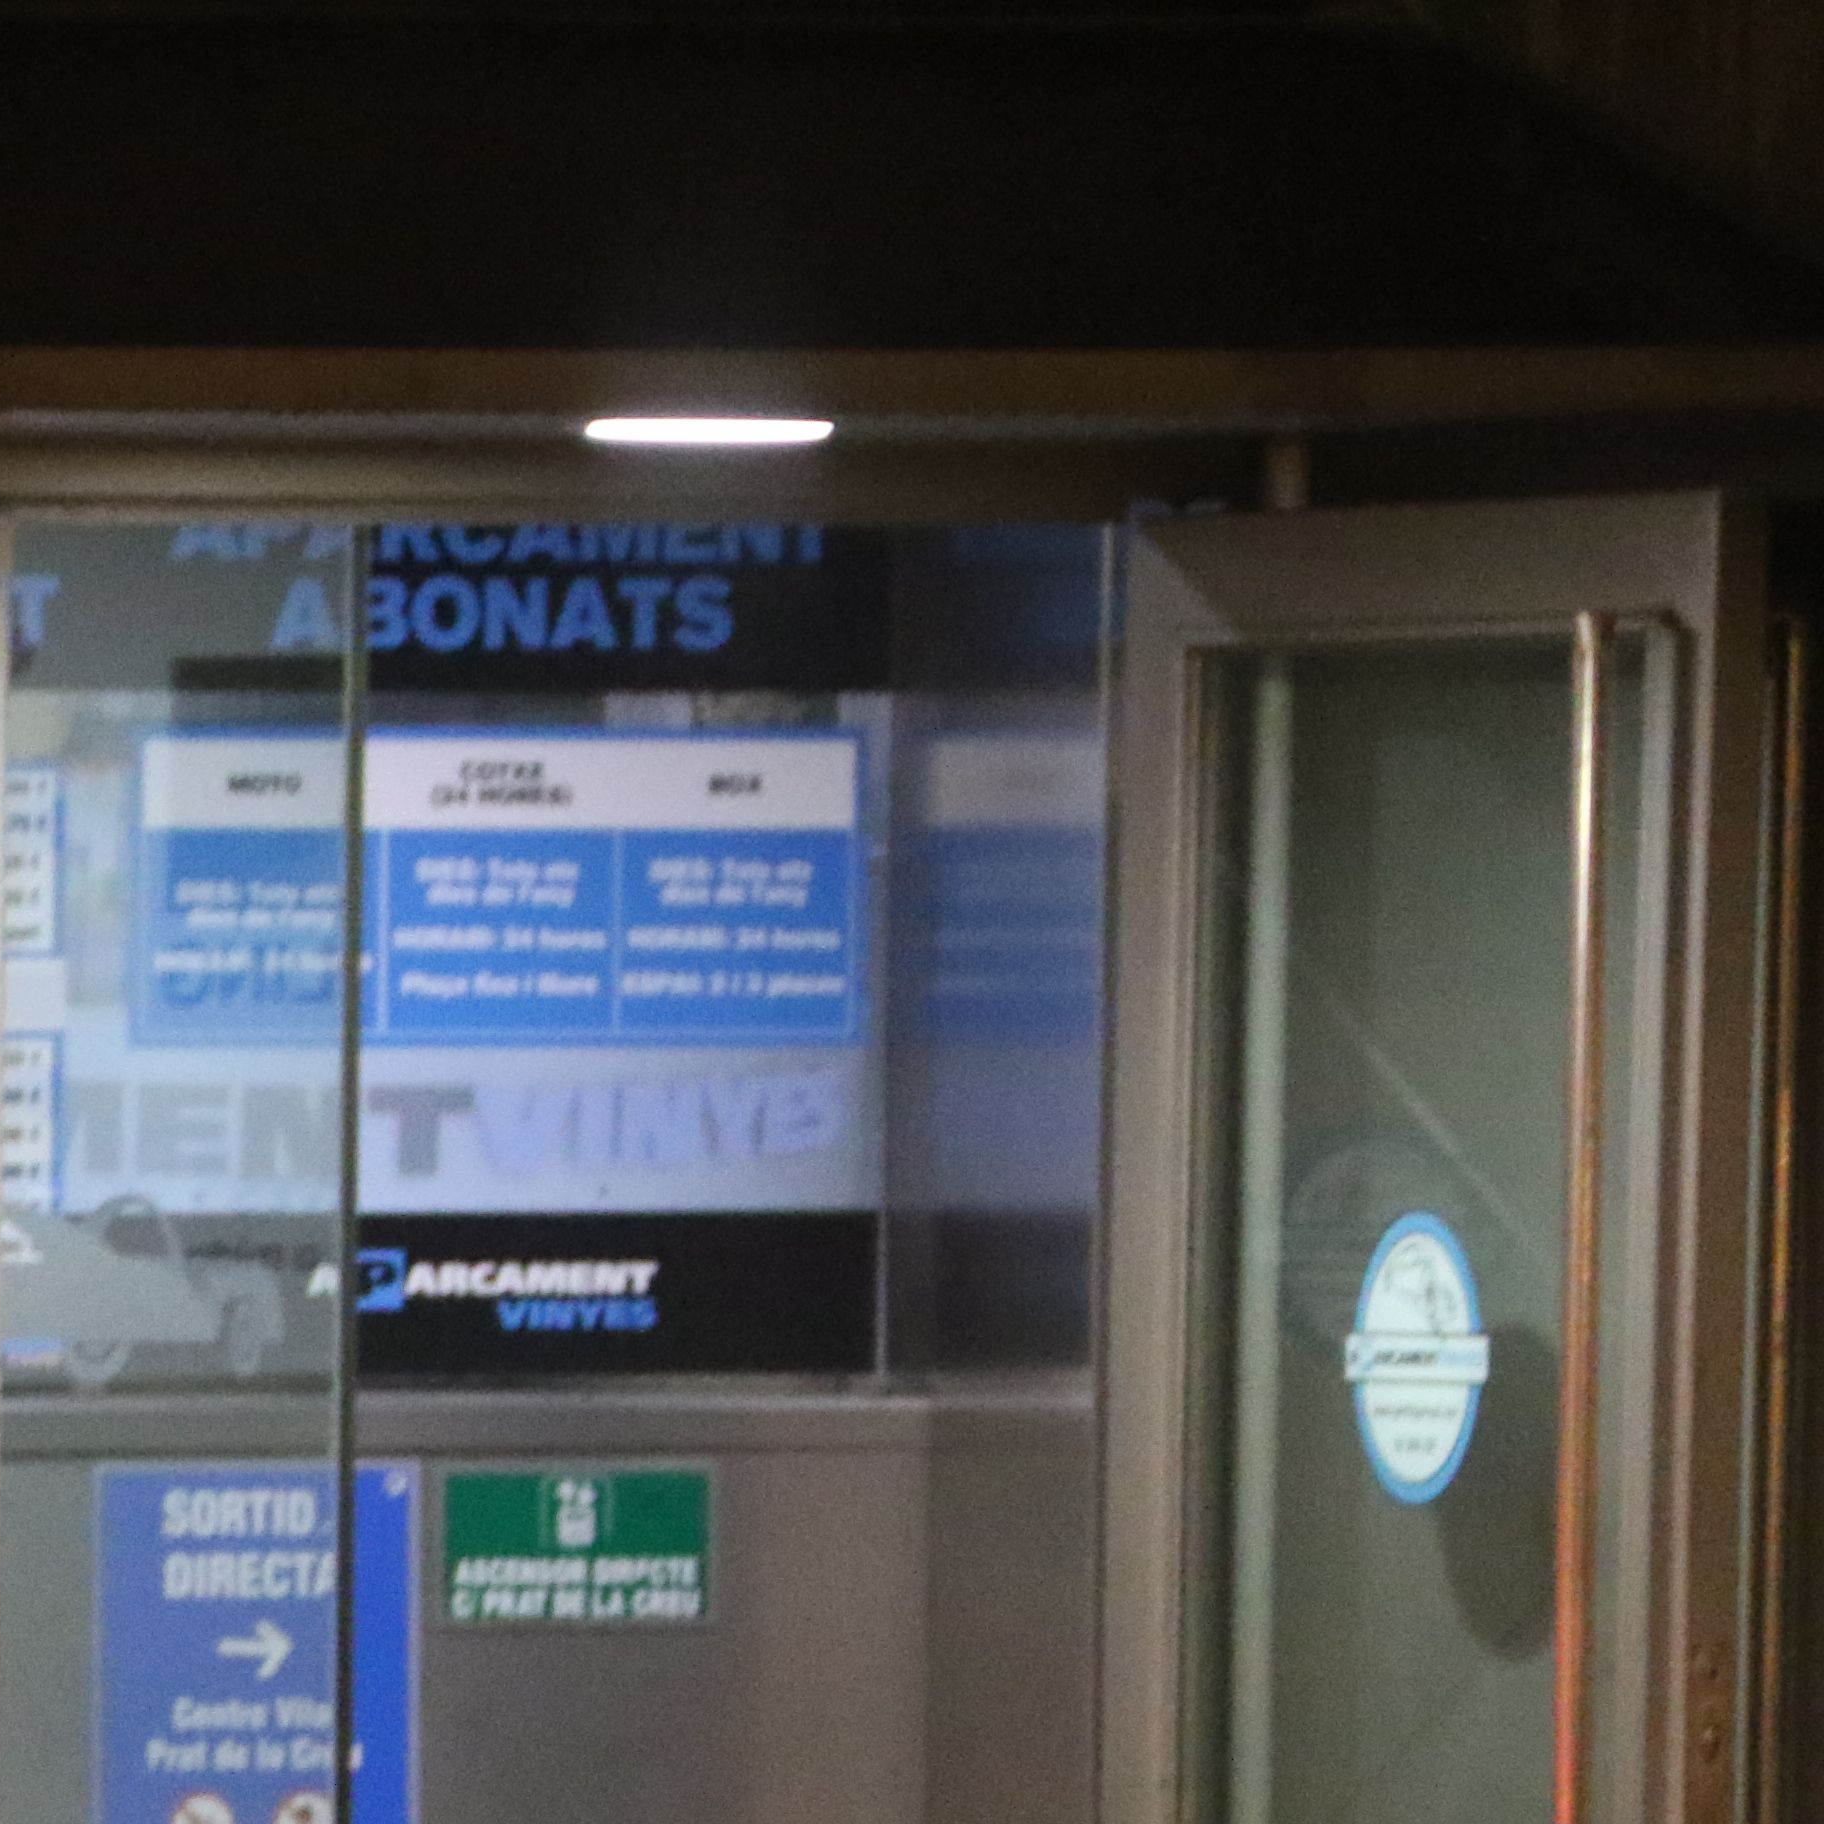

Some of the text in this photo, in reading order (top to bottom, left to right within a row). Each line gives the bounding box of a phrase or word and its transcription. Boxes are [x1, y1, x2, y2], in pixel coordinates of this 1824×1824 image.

[271, 574, 734, 652] ABONATS
[498, 1297, 655, 1331] VINYES
[162, 1488, 334, 1538] SORTID
[146, 1737, 206, 1772] Prat
[214, 1739, 250, 1772] de
